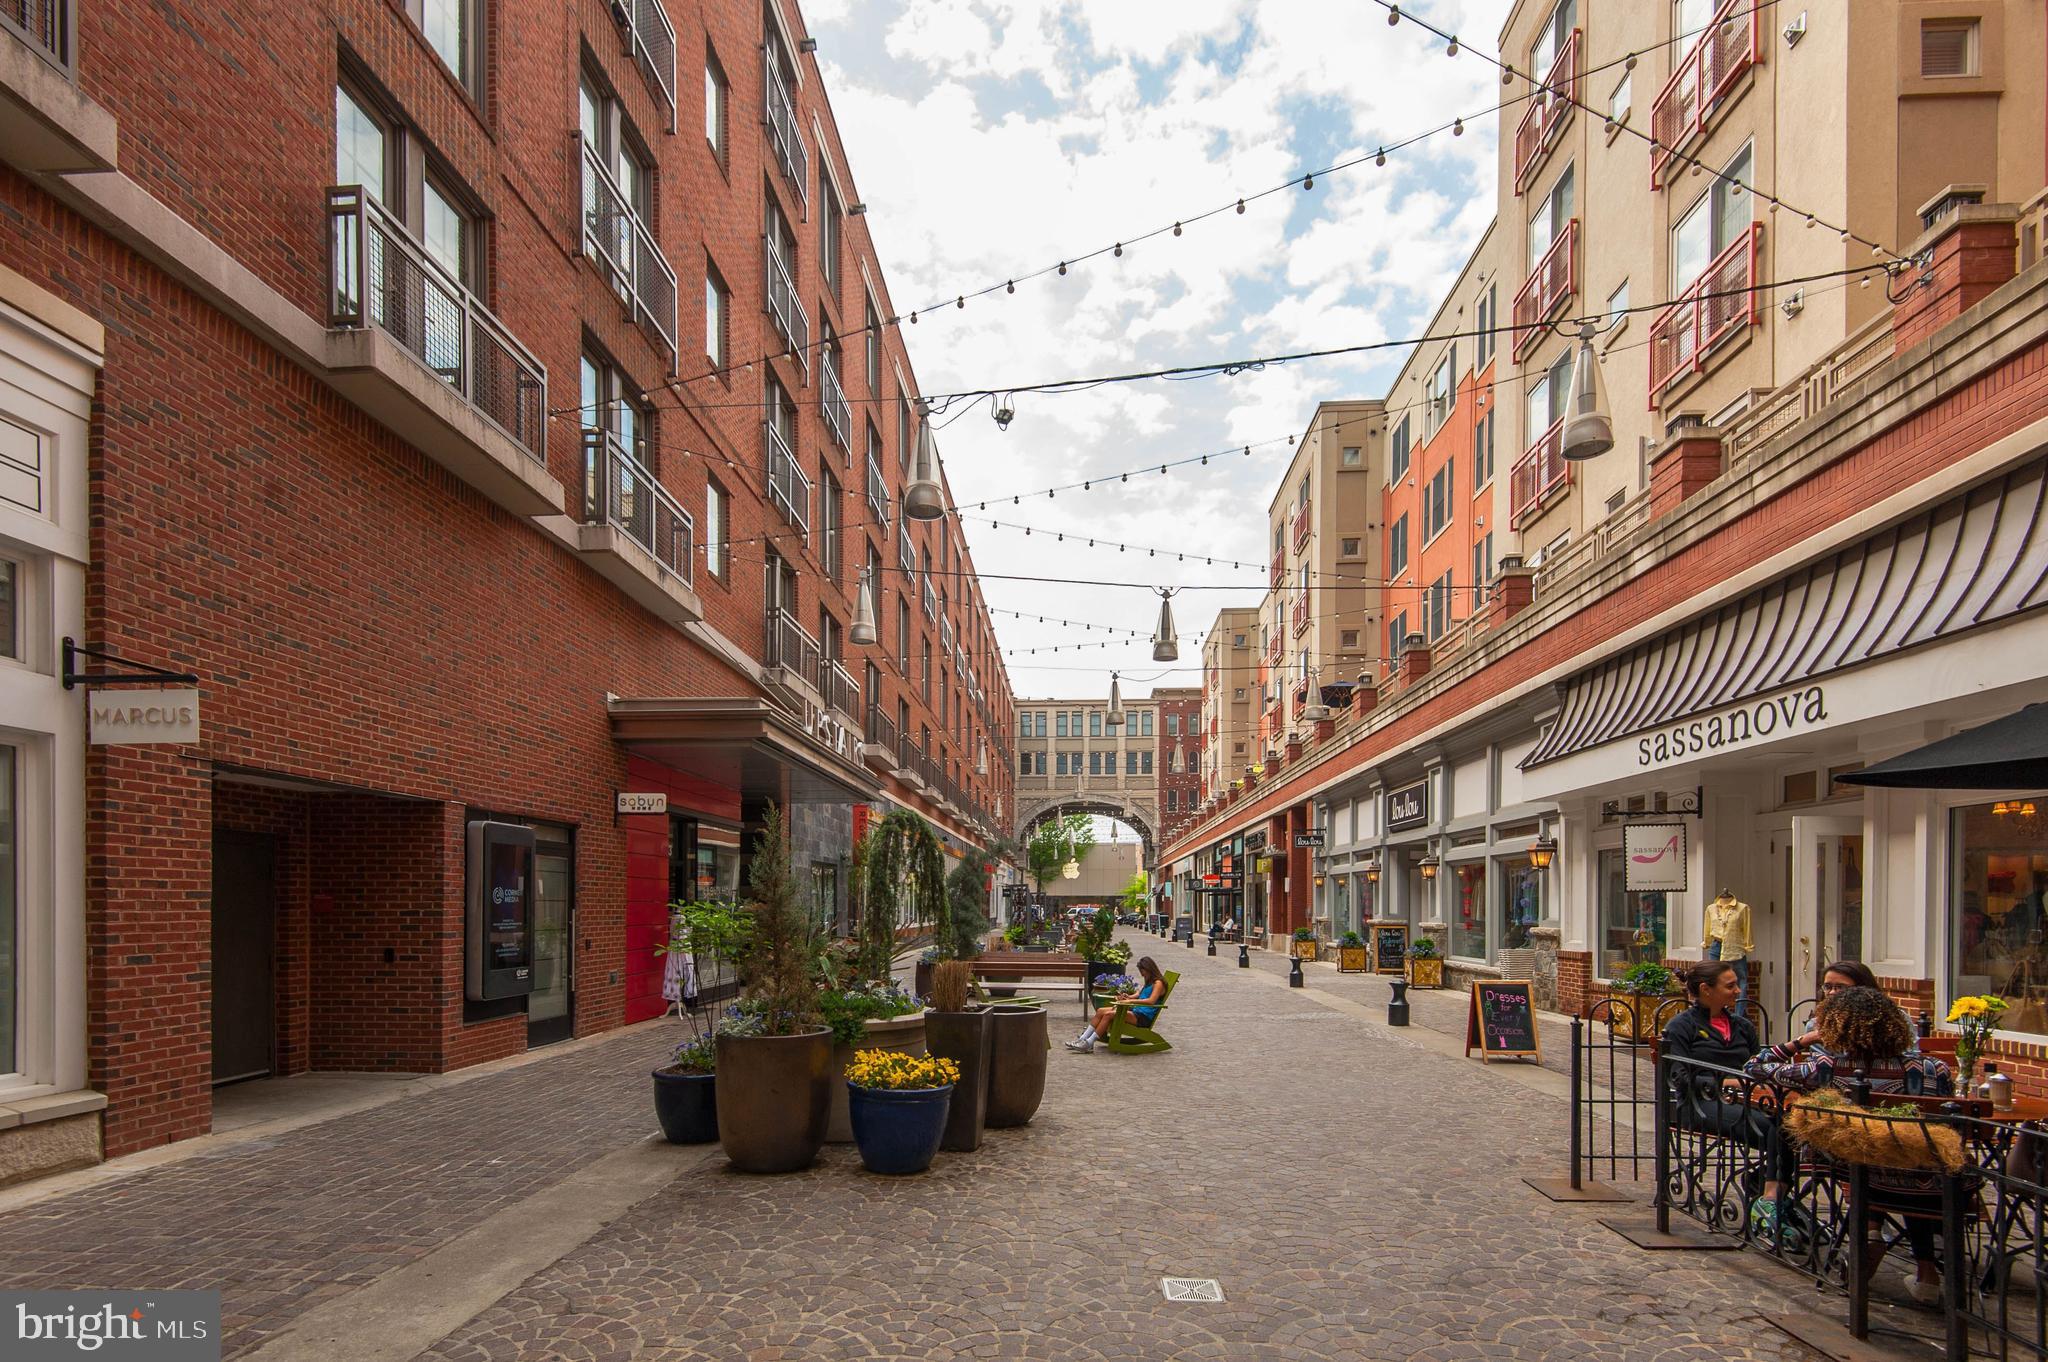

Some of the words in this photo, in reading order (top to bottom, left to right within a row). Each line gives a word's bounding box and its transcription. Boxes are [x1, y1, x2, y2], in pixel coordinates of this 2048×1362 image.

[94, 707, 192, 725] MARCUS
[1638, 686, 1828, 765] sassanova
[620, 795, 664, 807] sabun
[1485, 990, 1527, 1005] Dresses
[1501, 1001, 1513, 1012] for
[1491, 1011, 1521, 1026] Every
